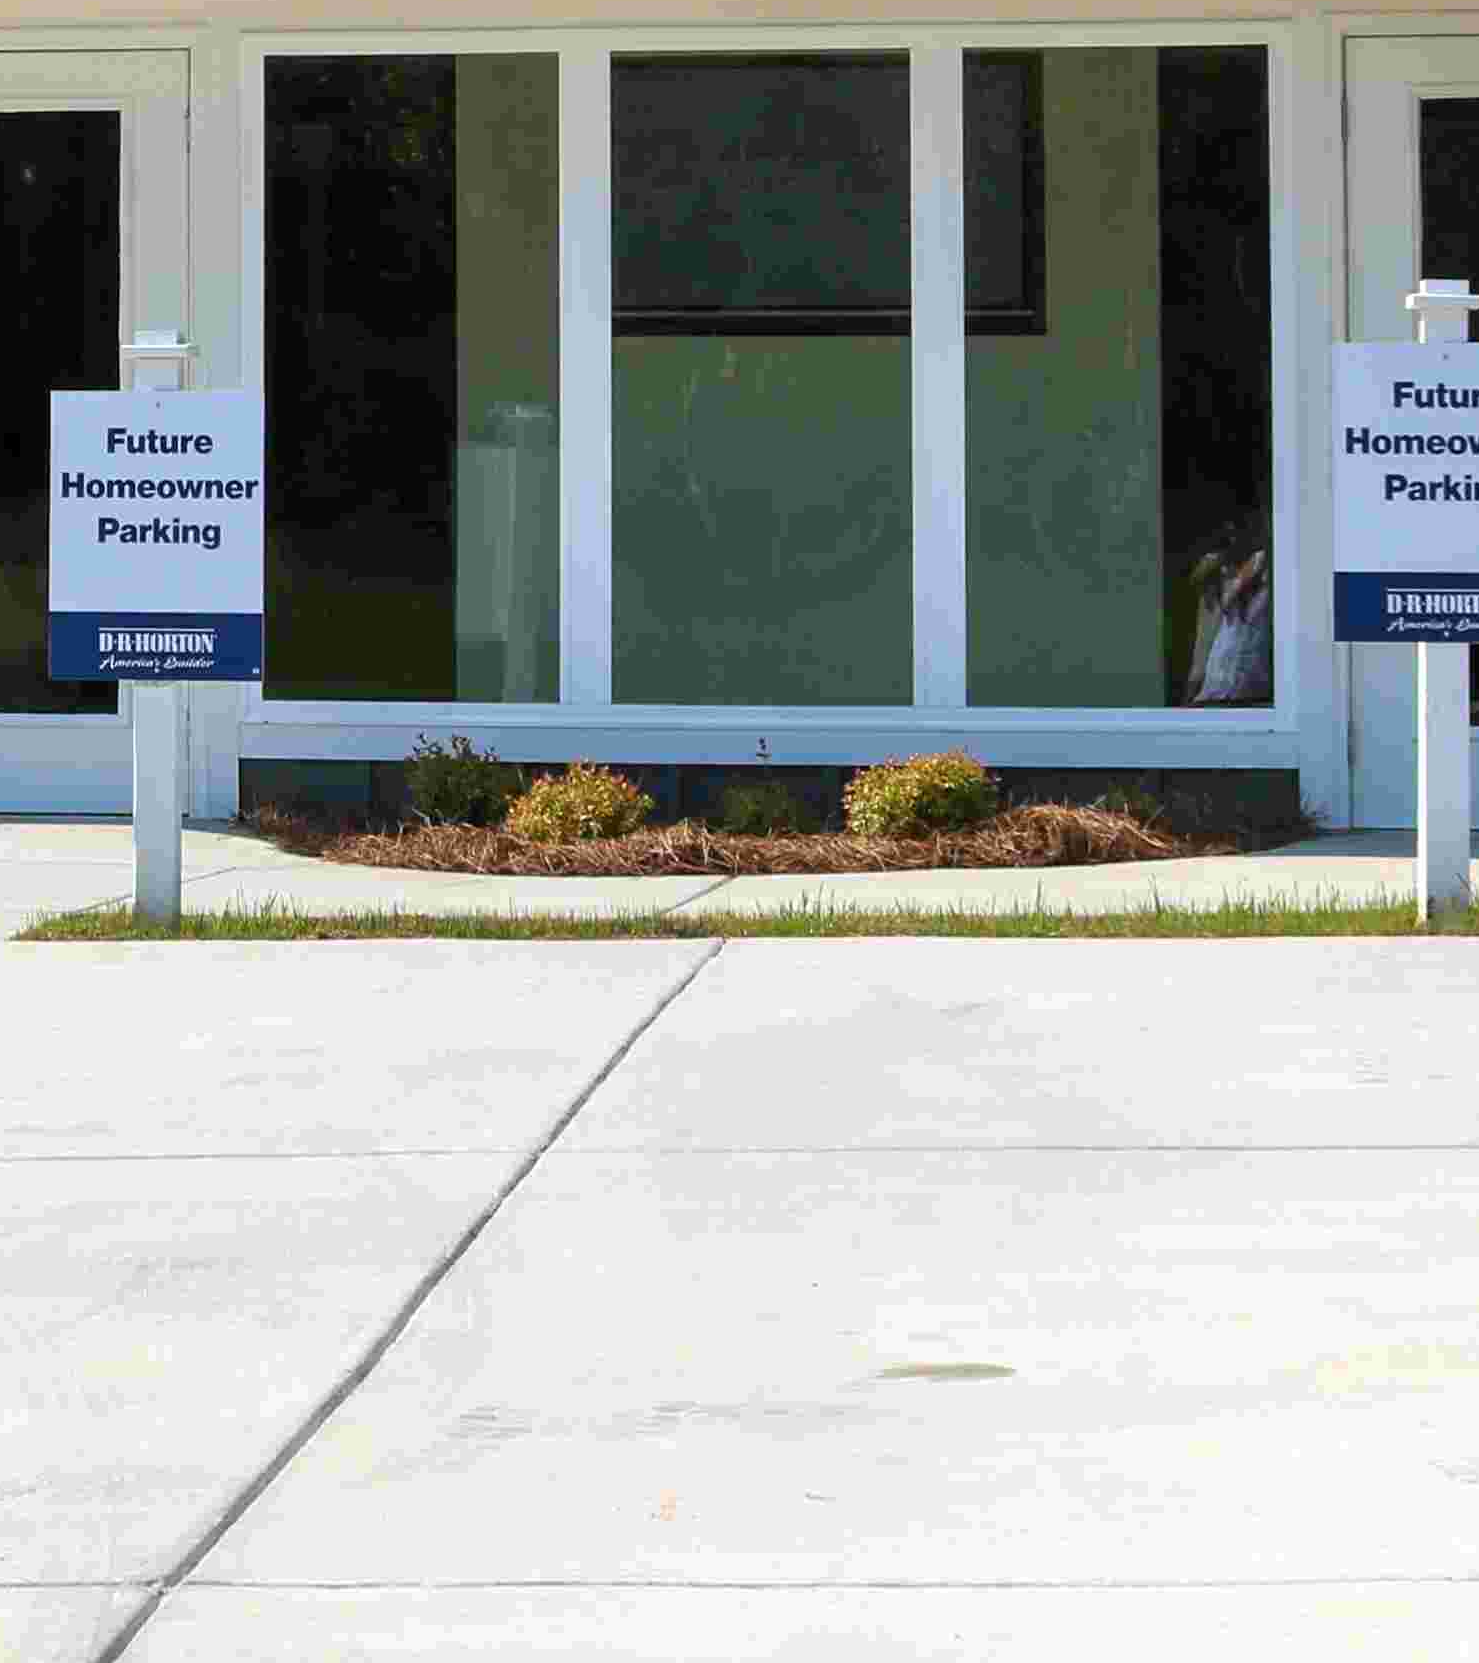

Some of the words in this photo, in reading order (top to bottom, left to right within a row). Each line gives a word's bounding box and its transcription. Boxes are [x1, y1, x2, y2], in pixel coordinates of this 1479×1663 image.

[108, 428, 212, 454] Future
[62, 473, 259, 499] Homeowner
[98, 518, 220, 549] Parking
